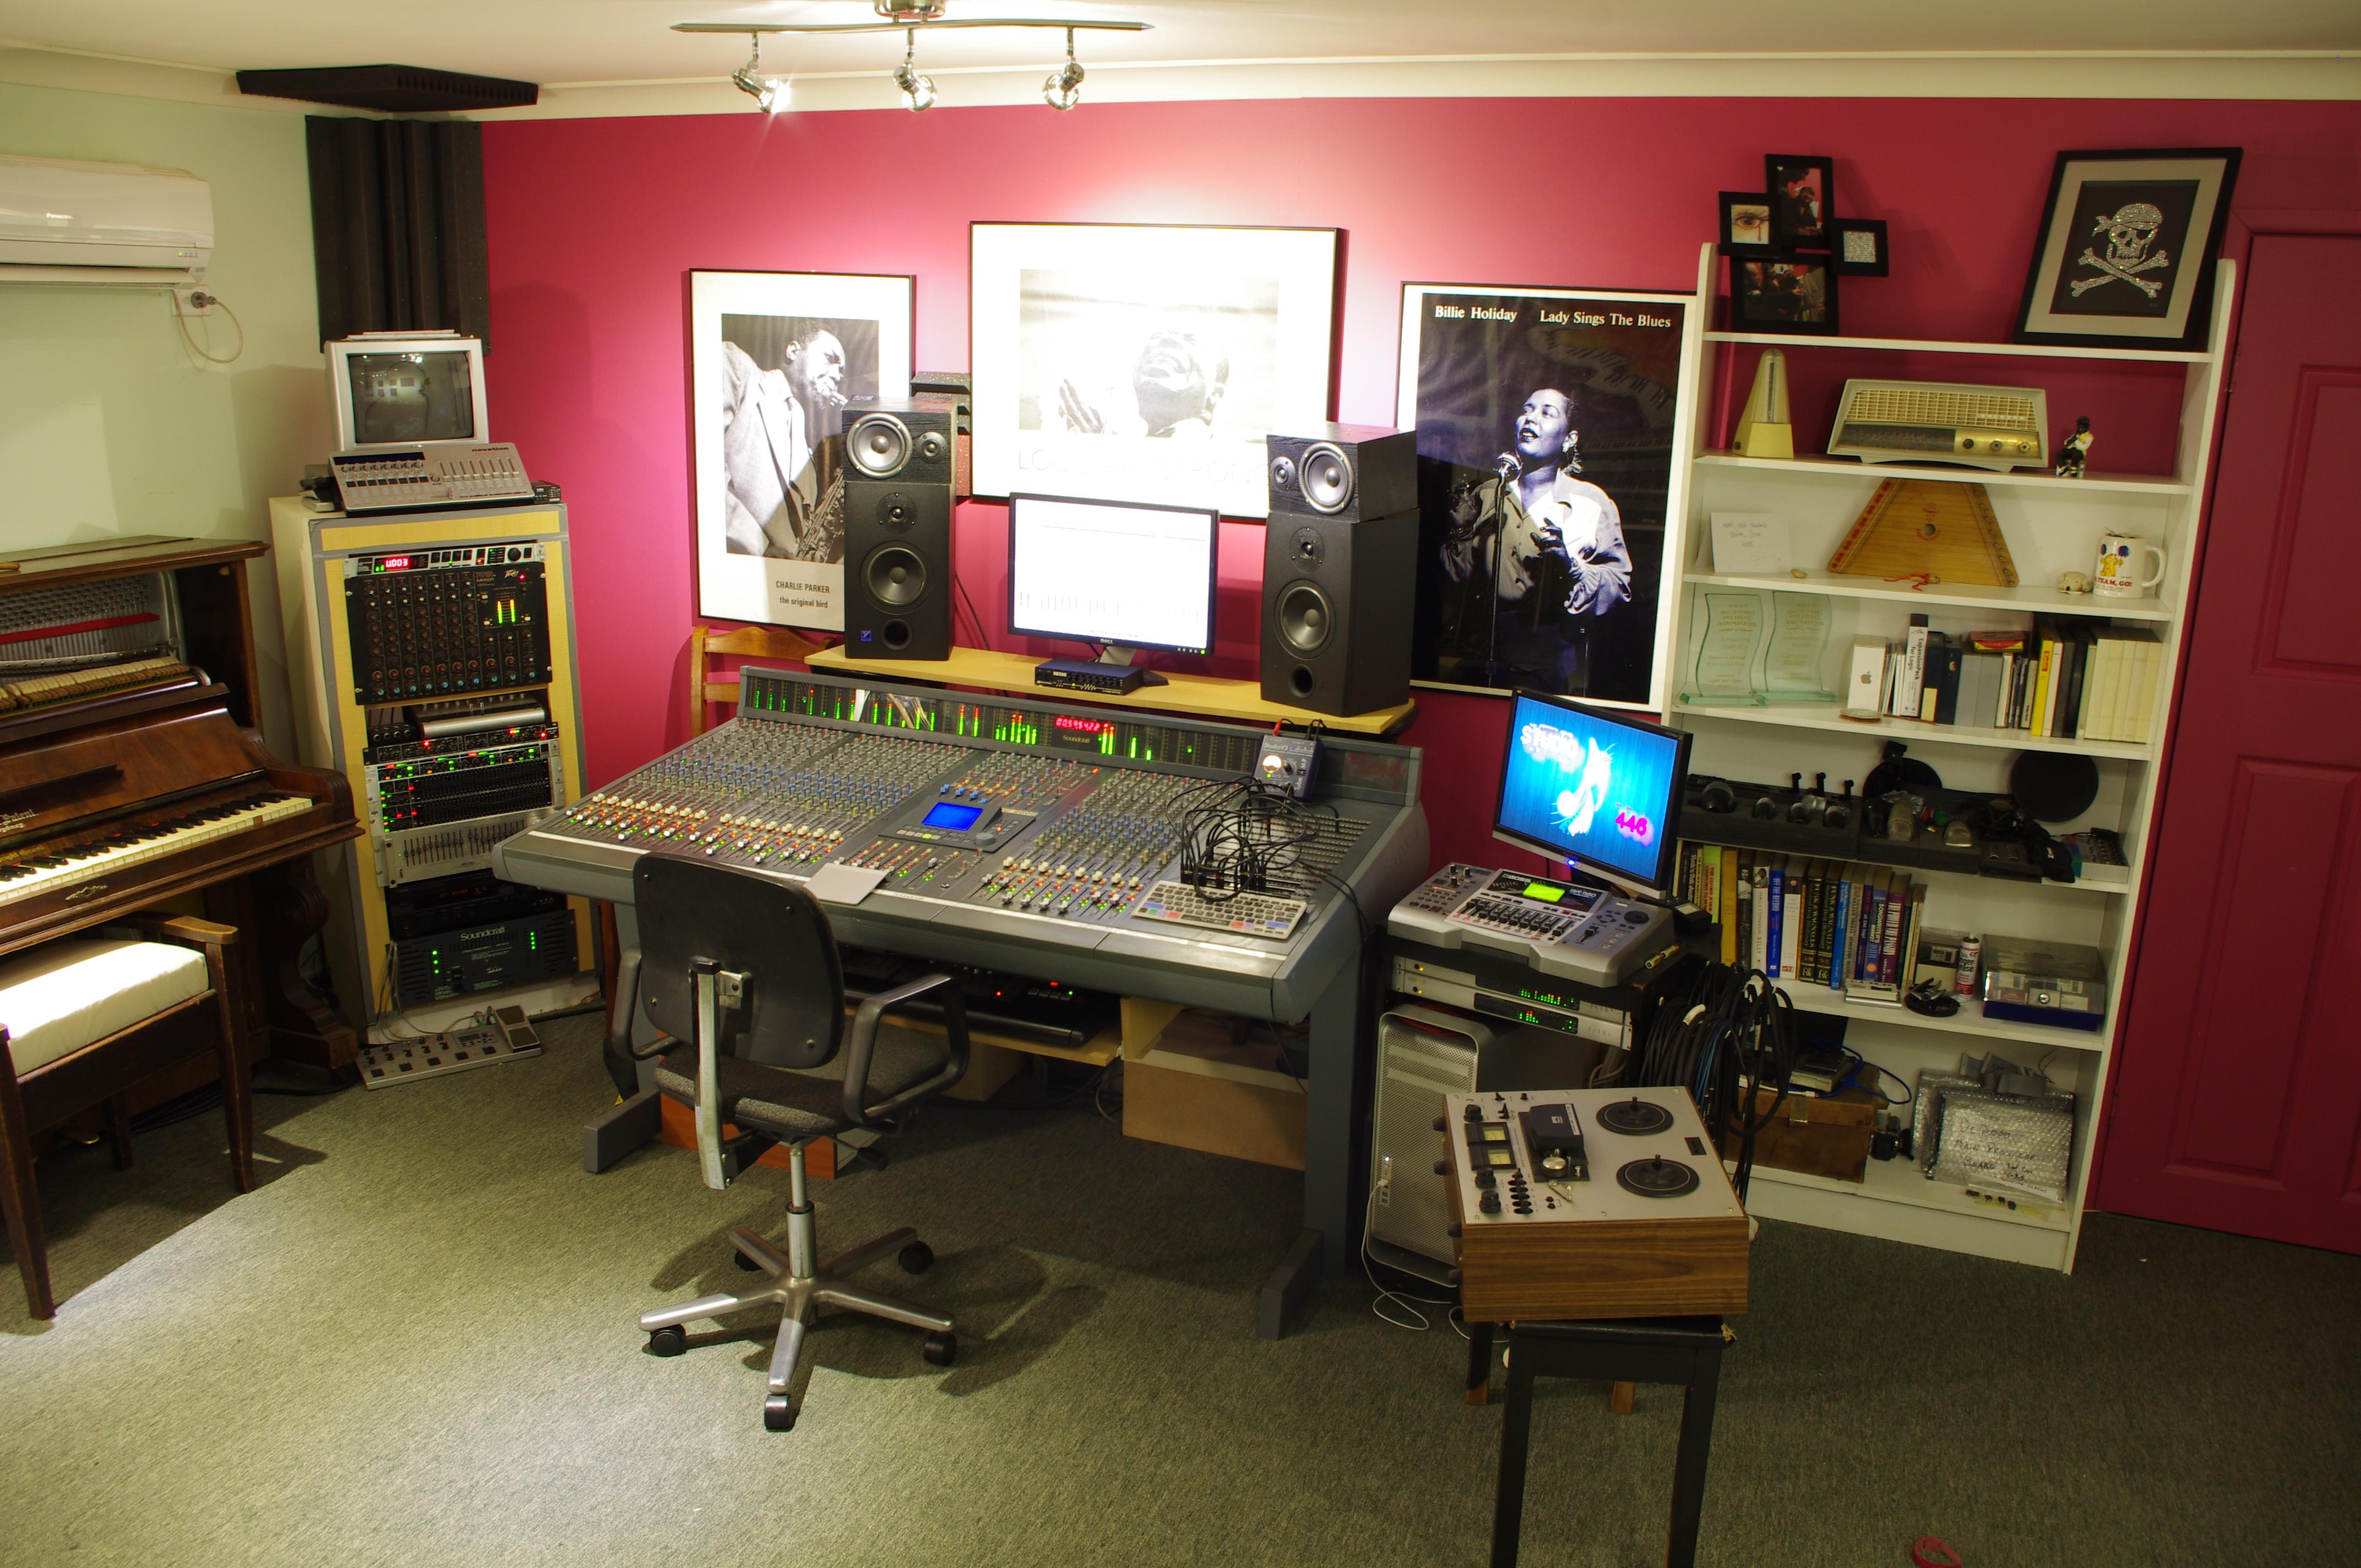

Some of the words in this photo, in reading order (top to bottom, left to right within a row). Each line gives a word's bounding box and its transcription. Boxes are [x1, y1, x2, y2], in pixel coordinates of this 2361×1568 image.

[1435, 305, 1466, 319] Billie
[1471, 307, 1518, 323] Holiday
[1540, 310, 1570, 325] Lady
[1573, 312, 1606, 326] Sings
[1609, 313, 1634, 326] The
[1638, 316, 1672, 329] Blues
[776, 581, 803, 590] CHARLIE
[804, 584, 830, 593] PARKER
[2098, 578, 2117, 586] TEAM,
[791, 598, 814, 607] original
[1913, 638, 1924, 680] ExpansionPack
[1063, 735, 1090, 743] Soundcraft
[1295, 777, 1303, 791] Tube
[1887, 901, 1901, 911] THE
[1874, 903, 1884, 943] SONGWRITER'S
[1886, 911, 1900, 928] POWER
[460, 926, 505, 940] Soundcraft
[1808, 910, 1817, 948] WAGNALLS
[1824, 912, 1832, 950] WAGNALLS
[1885, 927, 1898, 936] THE
[1883, 936, 1897, 956] PASSION
[1959, 957, 1974, 966] nger
[1964, 1157, 1995, 1169] BOARD
